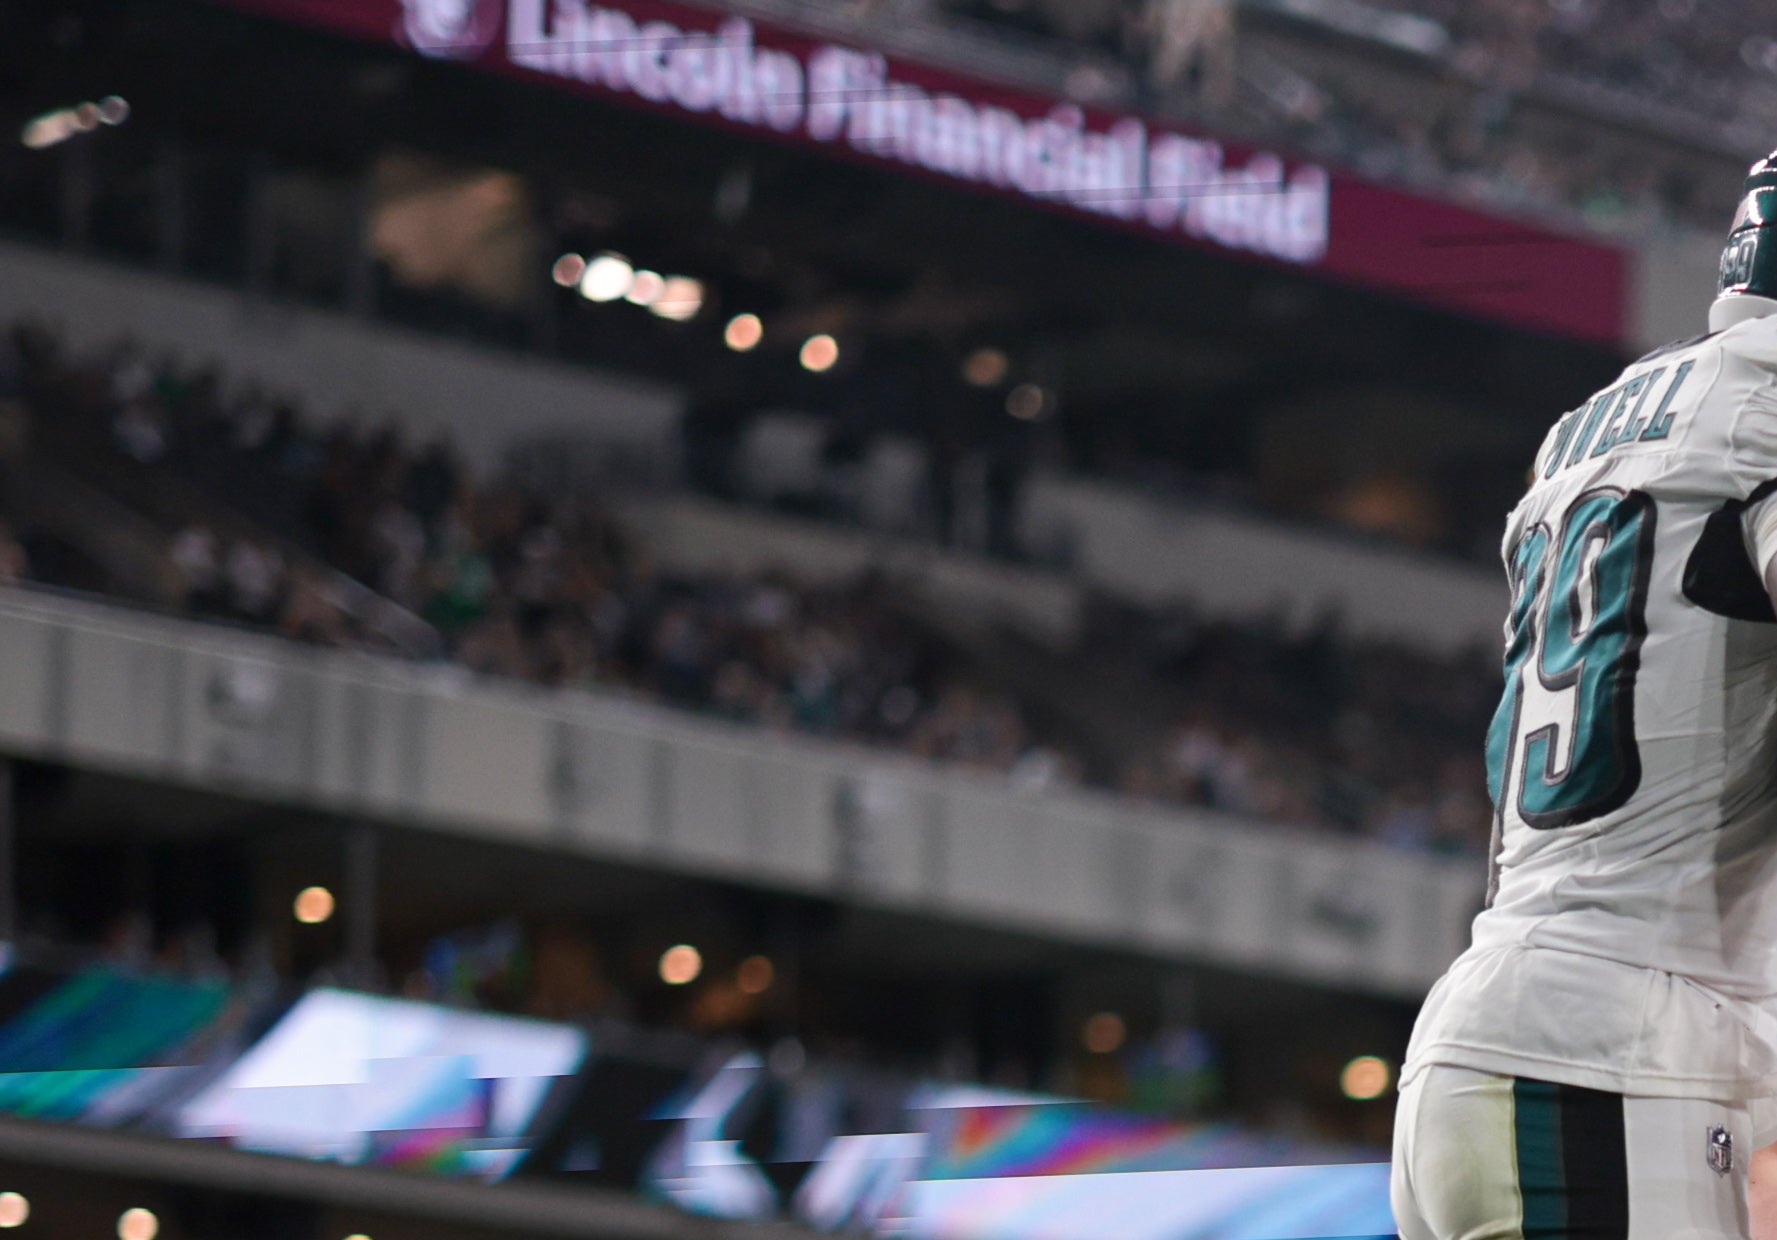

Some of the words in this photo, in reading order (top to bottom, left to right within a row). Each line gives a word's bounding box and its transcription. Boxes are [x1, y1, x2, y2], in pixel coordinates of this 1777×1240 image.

[507, 0, 804, 131] Lincoln
[808, 44, 1146, 222] Financial
[1147, 134, 1330, 263] Field
